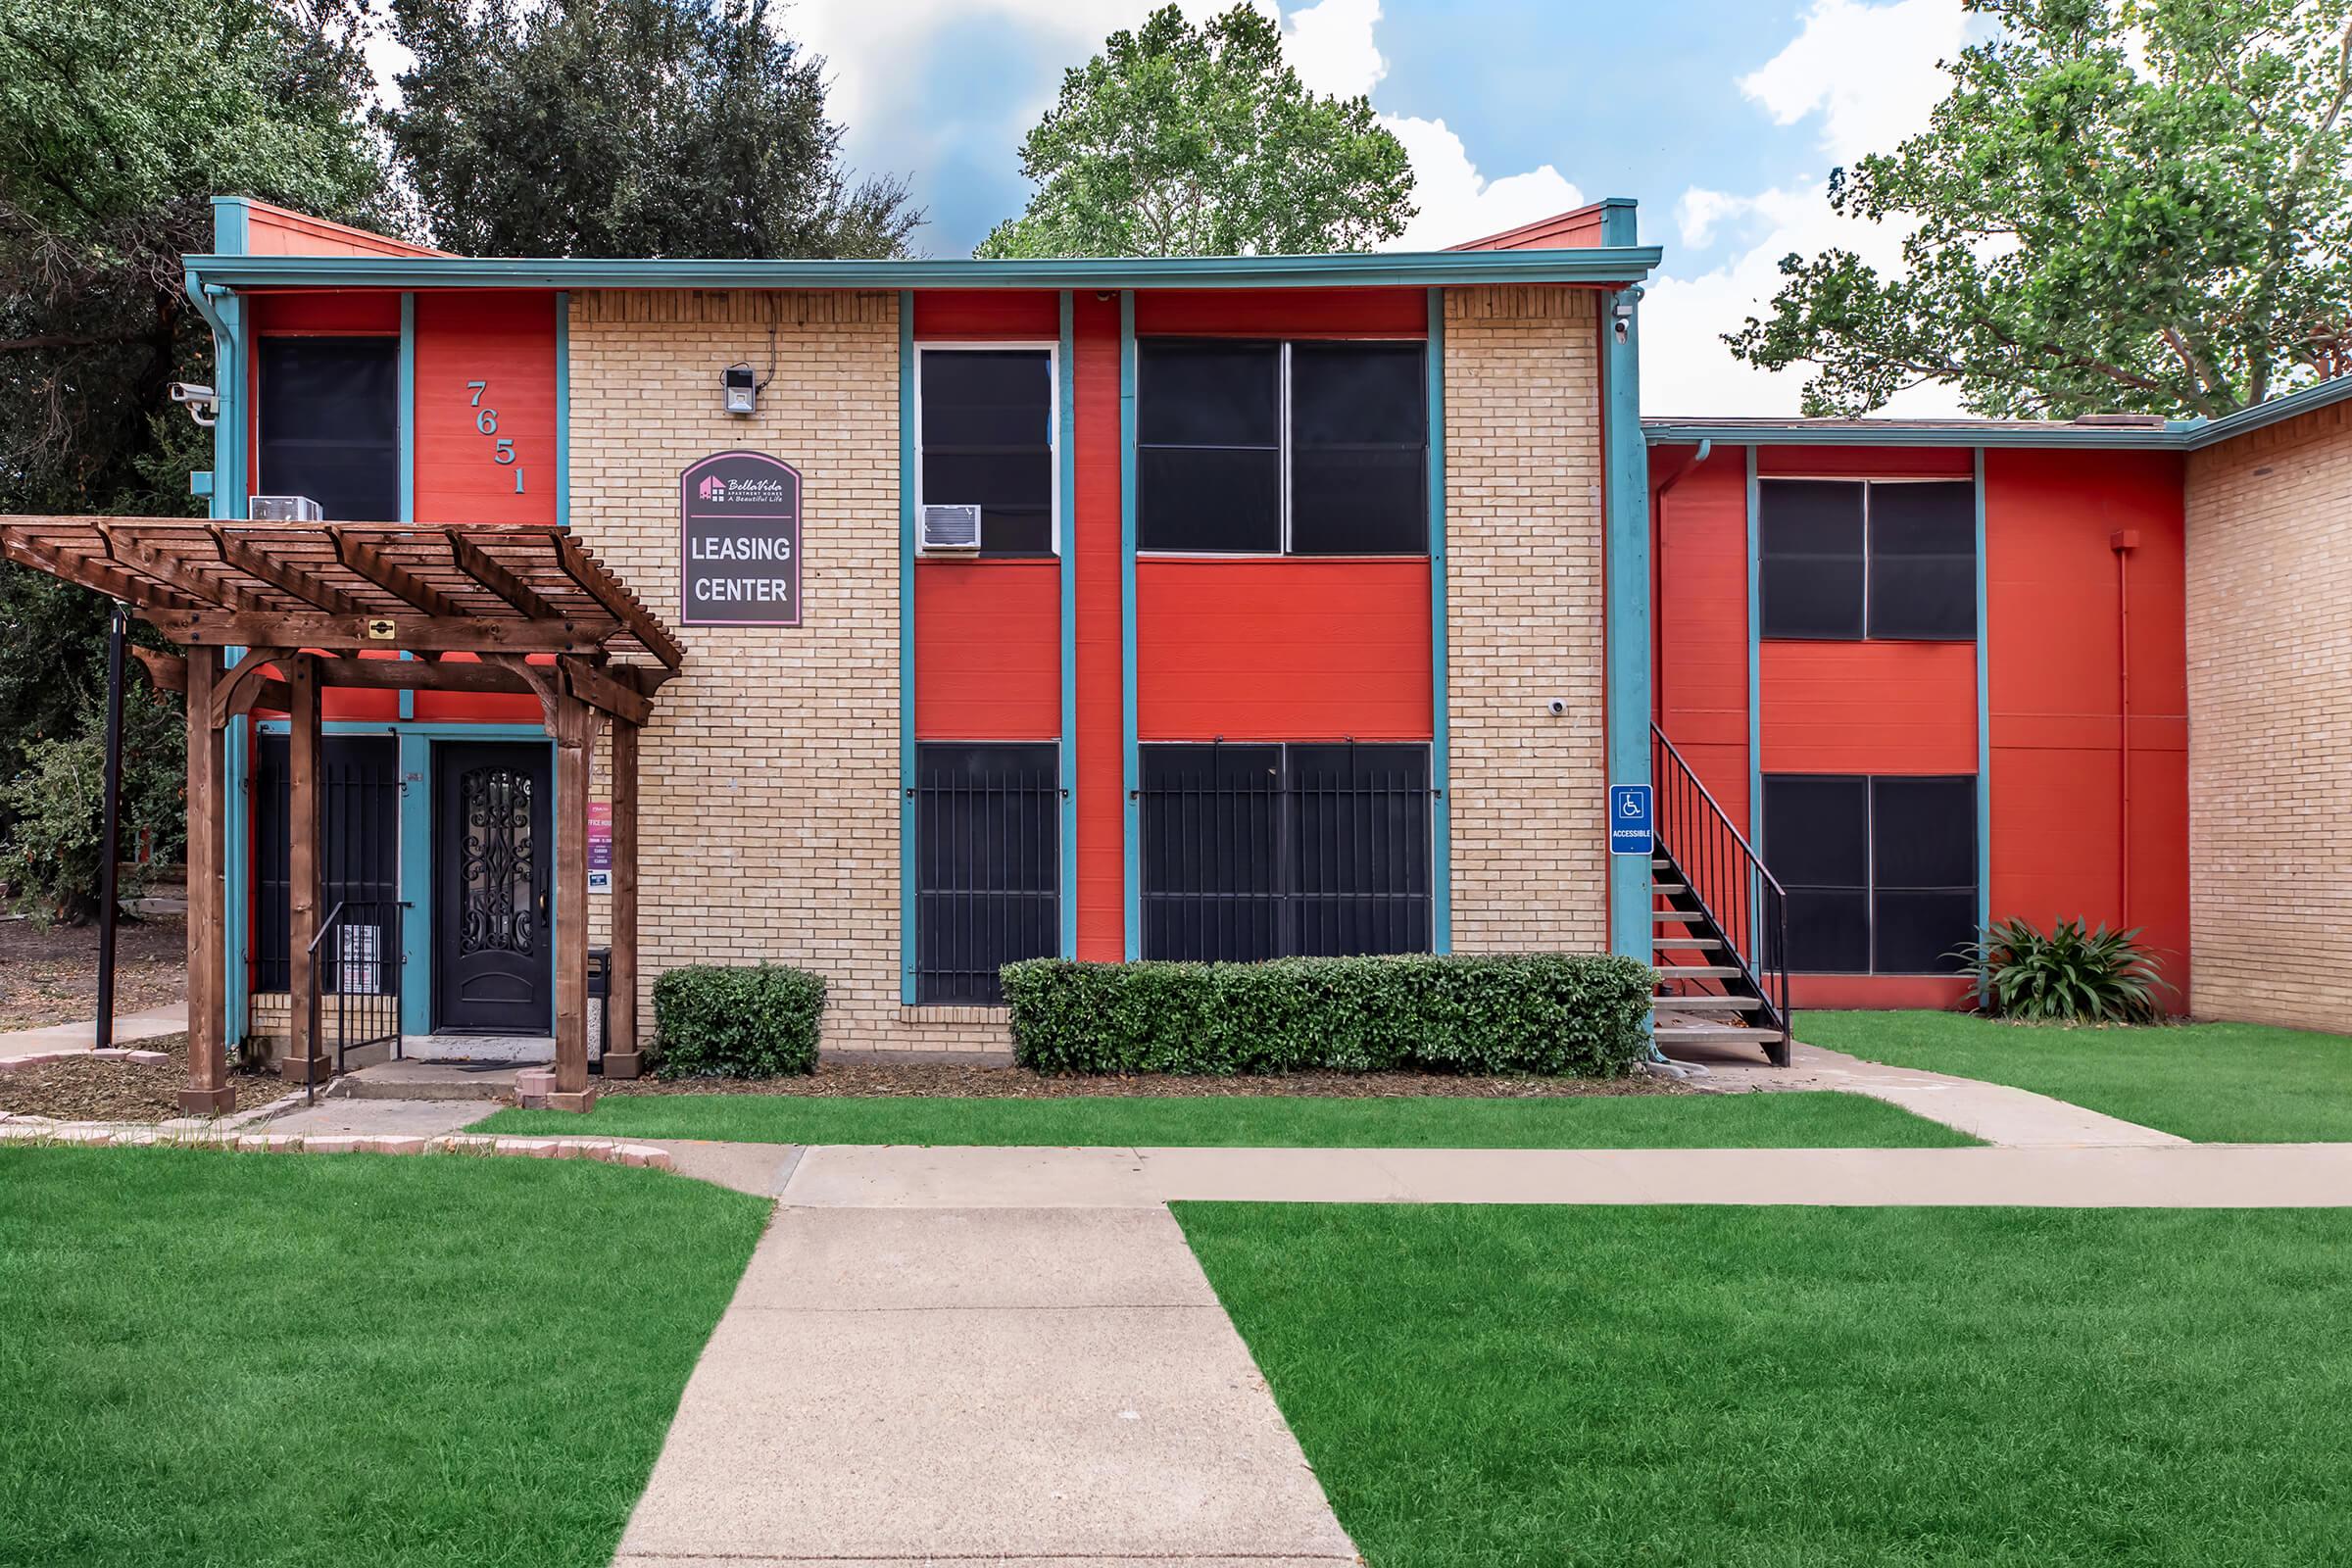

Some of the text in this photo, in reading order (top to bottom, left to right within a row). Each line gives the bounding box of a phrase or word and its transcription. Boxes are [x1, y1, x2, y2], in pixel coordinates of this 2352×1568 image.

[727, 479, 783, 491] BellaVida
[692, 537, 790, 561] LEASING
[695, 577, 787, 602] CENTER
